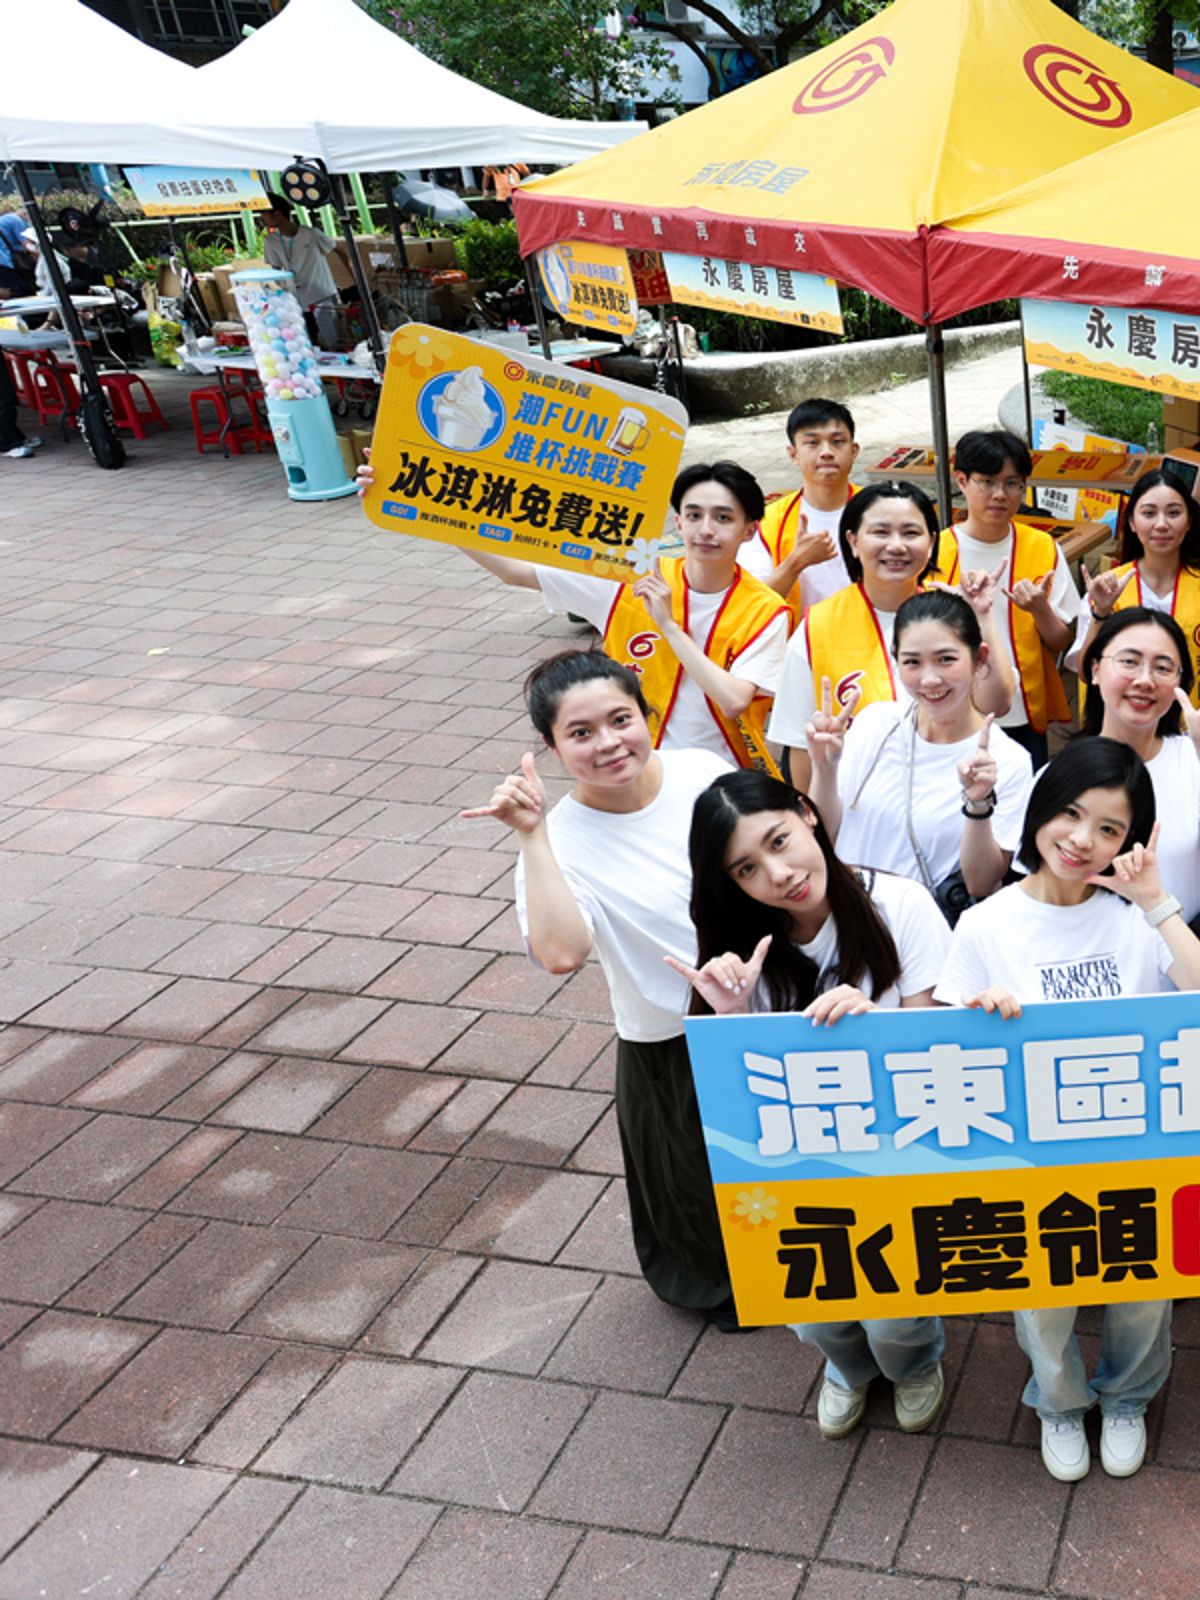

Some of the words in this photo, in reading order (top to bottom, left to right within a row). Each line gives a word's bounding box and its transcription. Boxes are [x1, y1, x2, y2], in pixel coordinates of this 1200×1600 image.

[702, 257, 796, 300] 永慶房屋
[513, 392, 609, 441] 潮FUN
[504, 431, 647, 491] 推杯挑戰賽
[388, 452, 645, 546] 冰淇淋免費送!
[629, 632, 661, 659] 6
